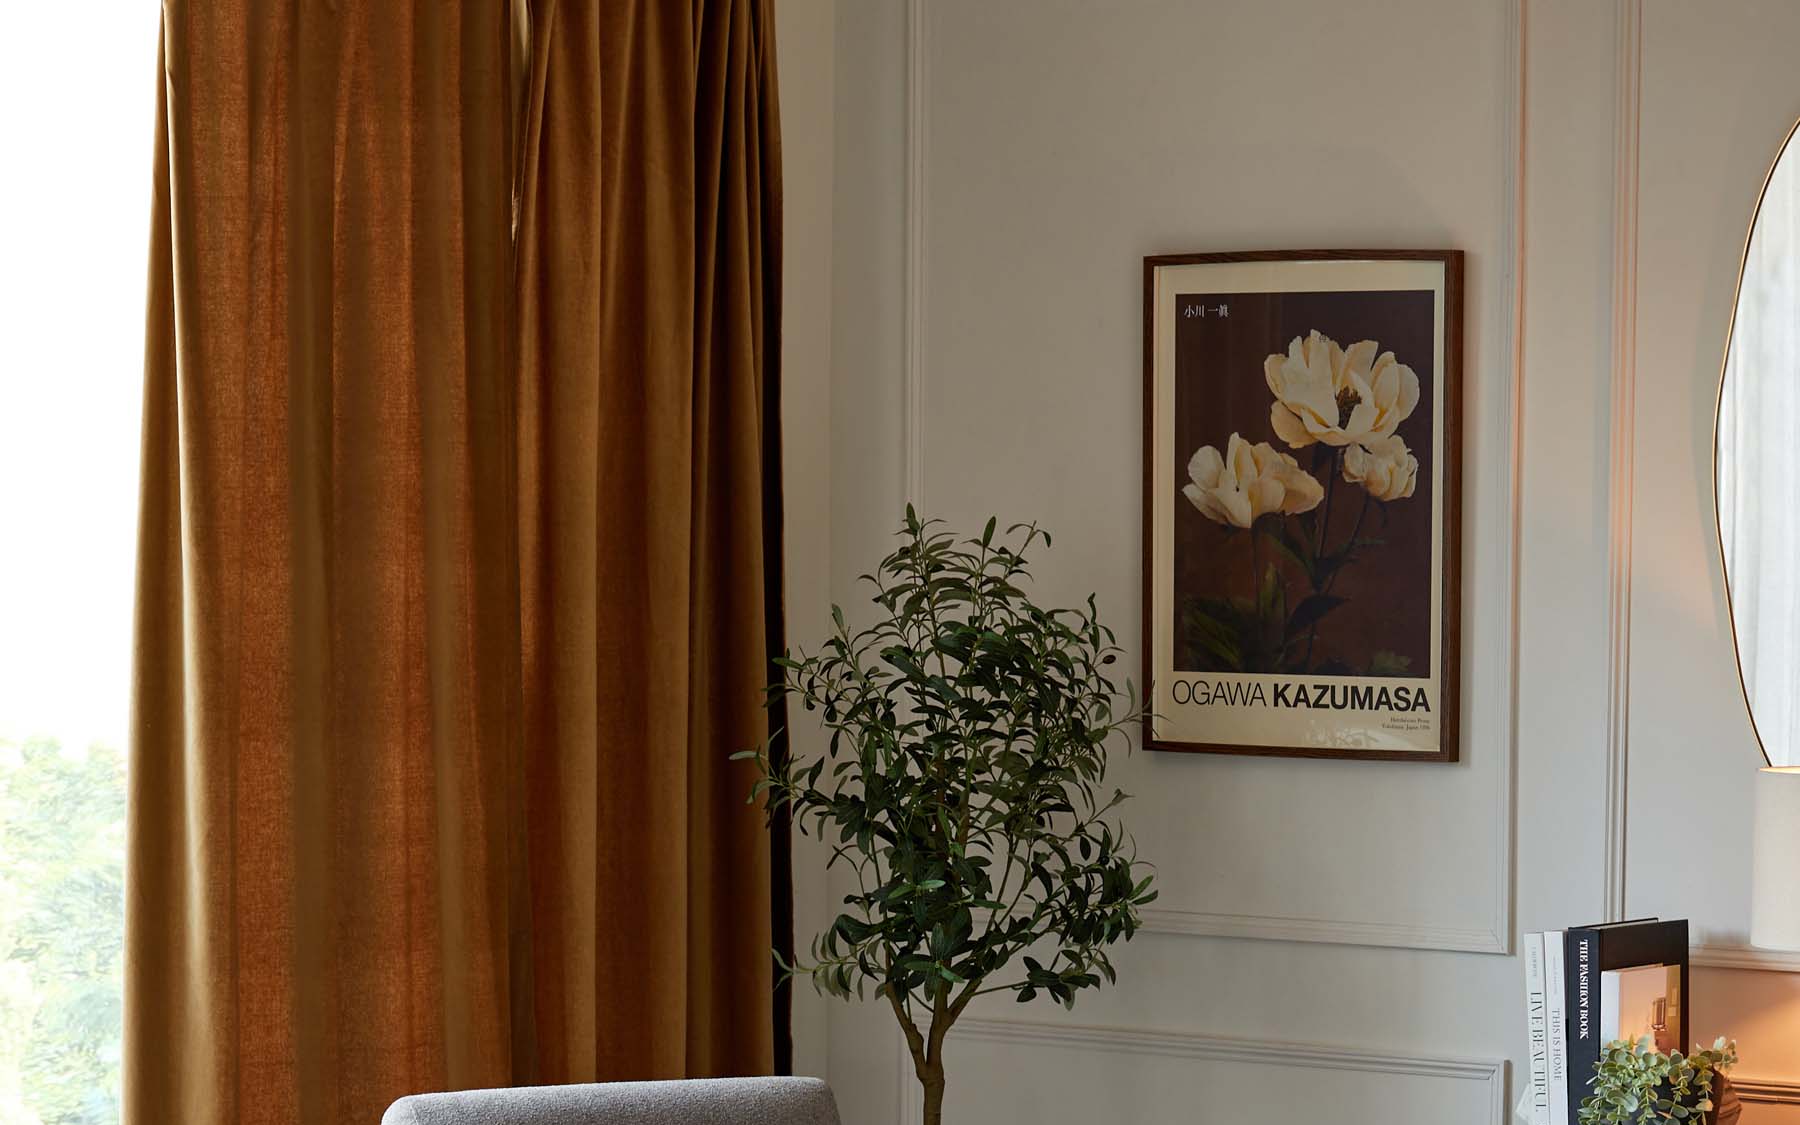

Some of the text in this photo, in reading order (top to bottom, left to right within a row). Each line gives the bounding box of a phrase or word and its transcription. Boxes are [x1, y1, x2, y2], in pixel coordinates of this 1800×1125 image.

[1172, 680, 1431, 712] OGAWA KAZUMASA
[1531, 992, 1543, 1025] LIVE
[1580, 939, 1588, 1039] THE FASHION BOOK
[1532, 1030, 1546, 1112] BEAUTIFUL
[1552, 1008, 1561, 1080] THIS IS HOME
